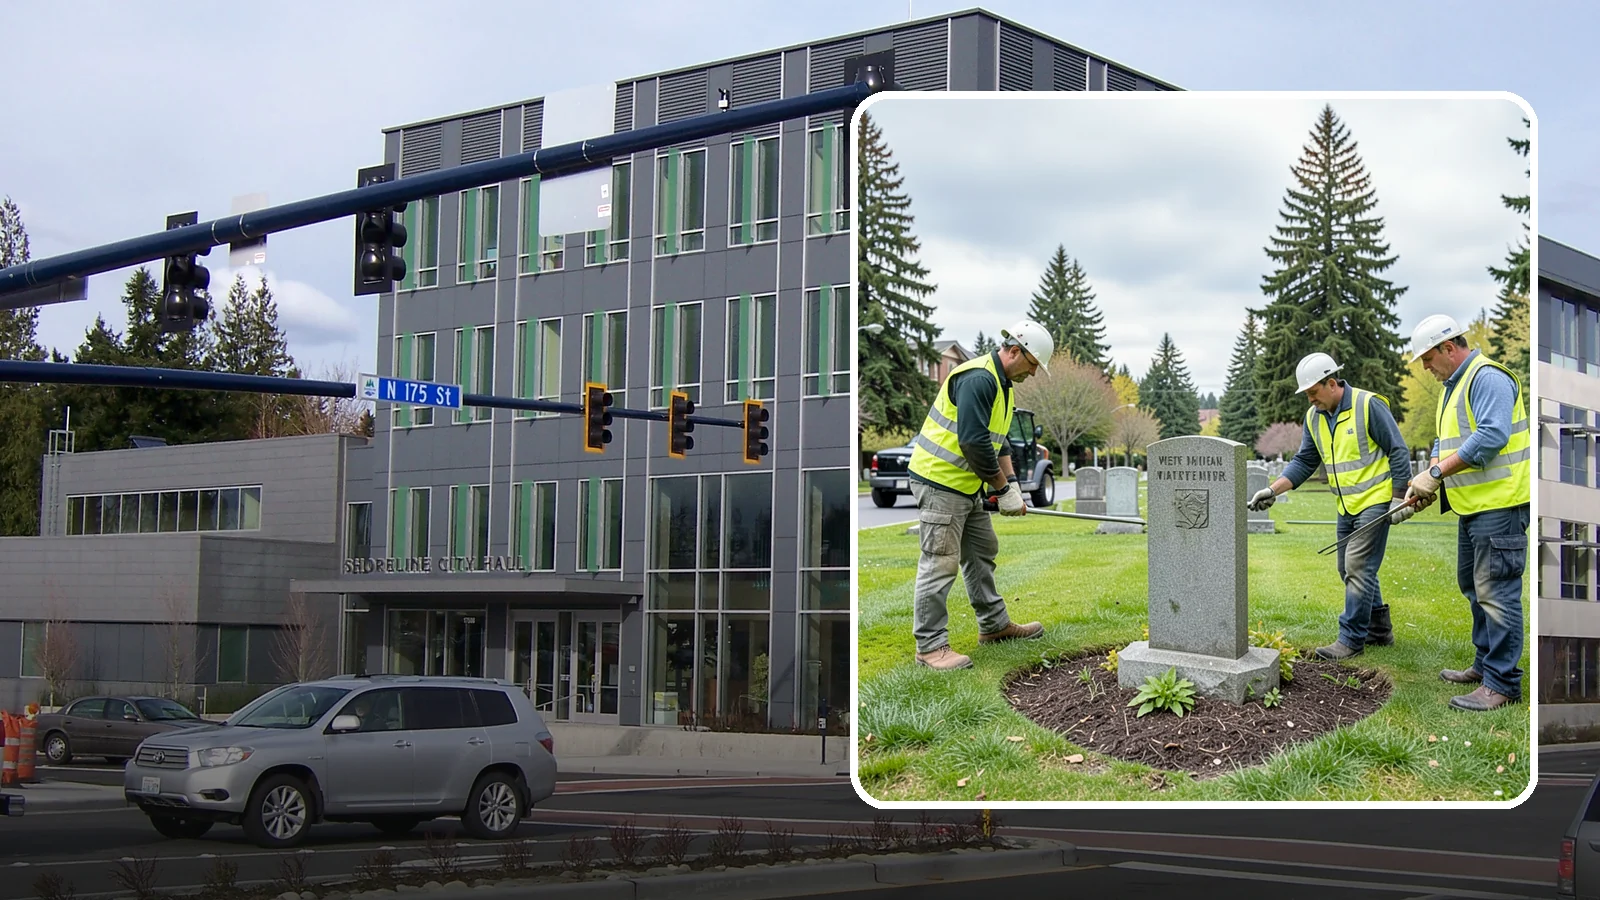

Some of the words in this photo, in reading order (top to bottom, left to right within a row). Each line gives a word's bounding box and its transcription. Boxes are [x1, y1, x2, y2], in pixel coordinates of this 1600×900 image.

[387, 380, 396, 400] N
[405, 382, 427, 403] 175
[436, 386, 451, 406] St
[344, 557, 432, 574] SHORELINE
[438, 556, 476, 572] CITY
[483, 555, 525, 571] HALL
